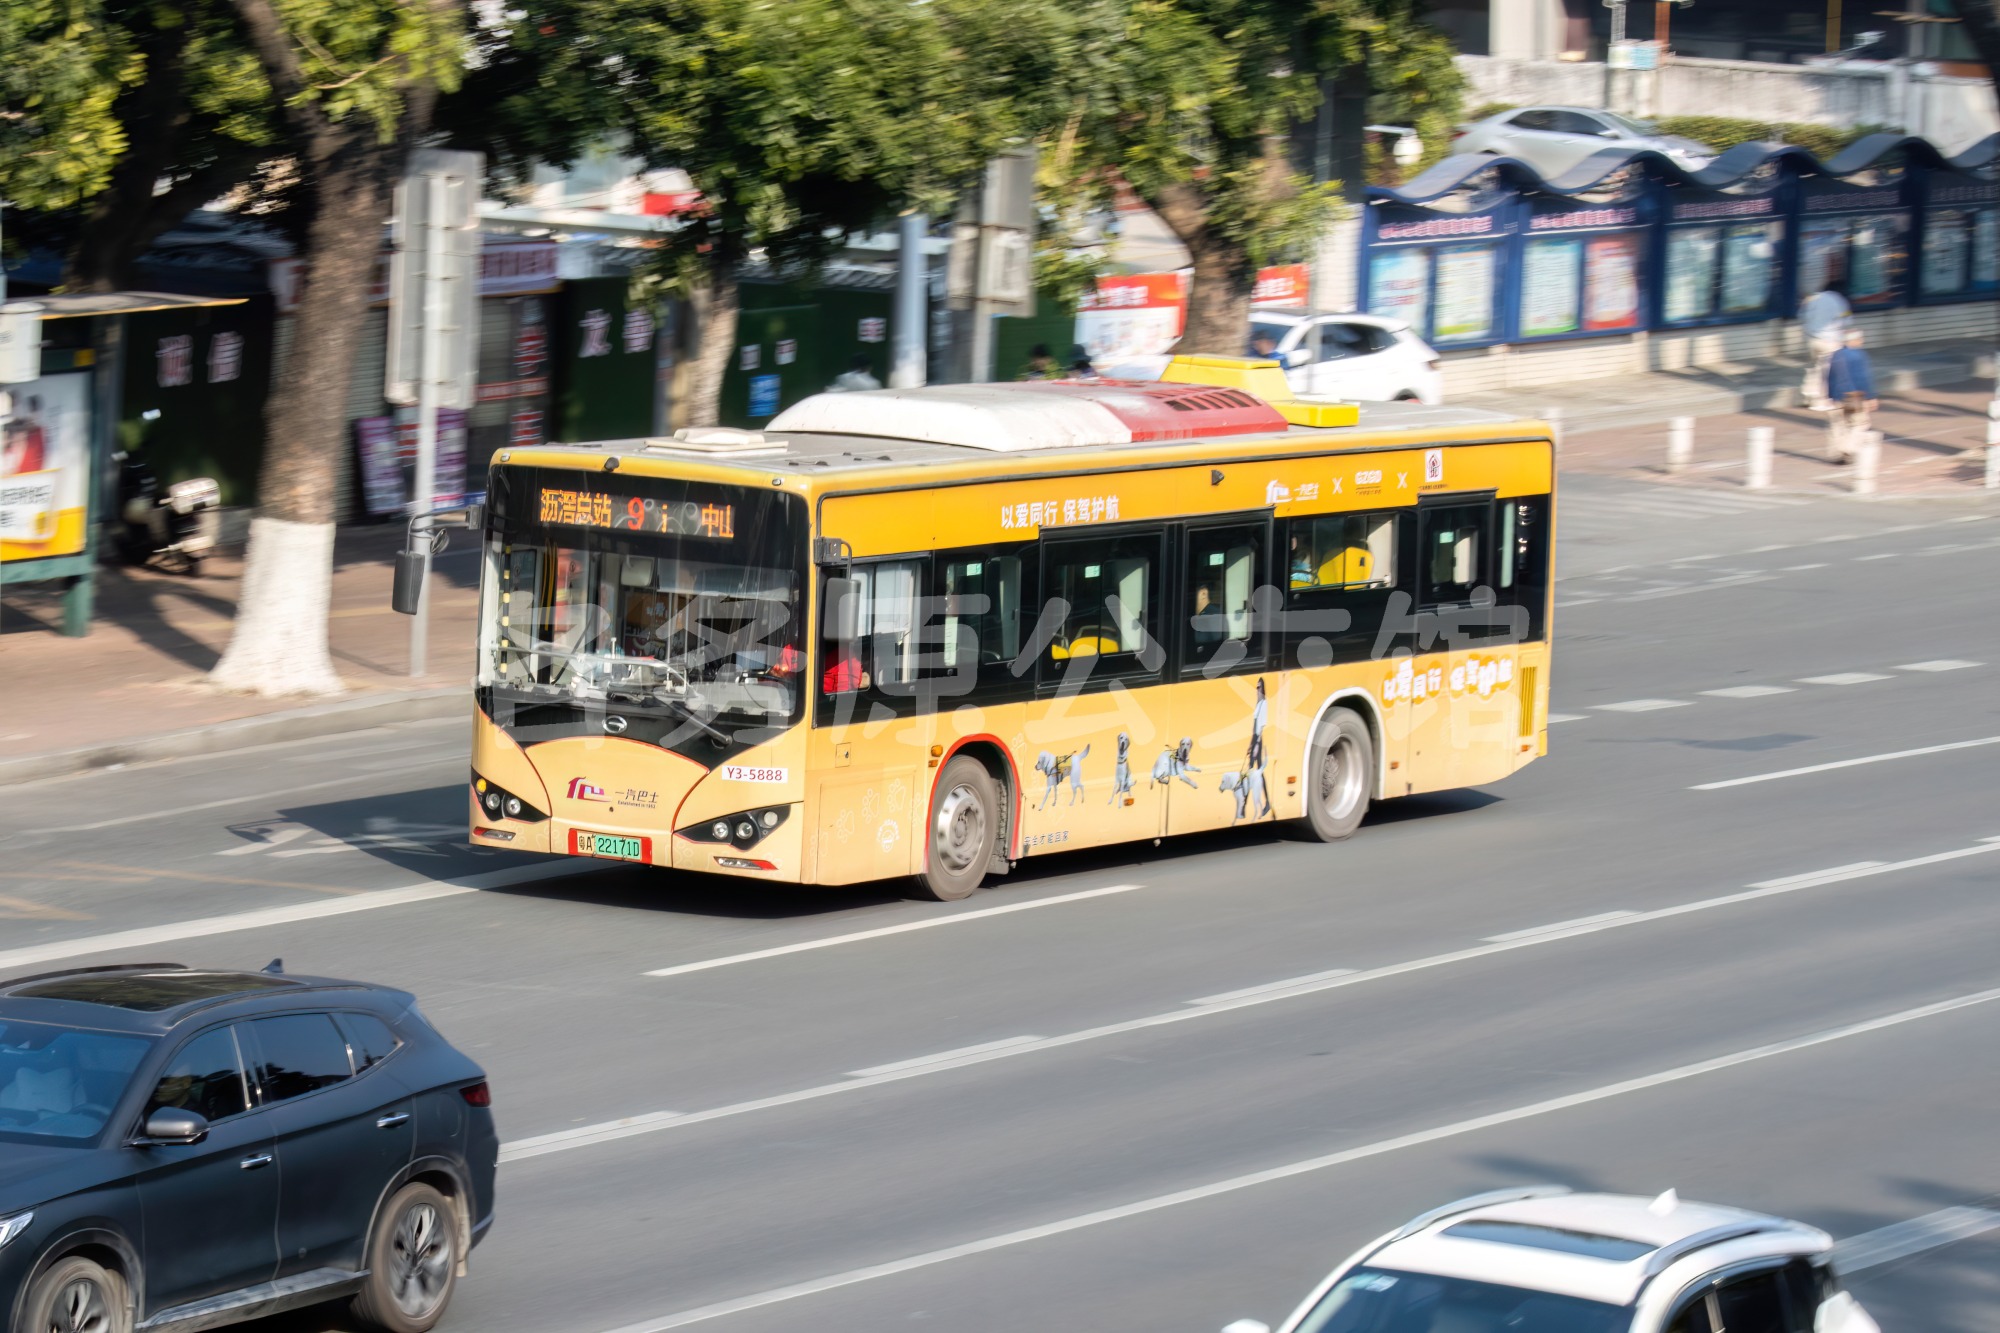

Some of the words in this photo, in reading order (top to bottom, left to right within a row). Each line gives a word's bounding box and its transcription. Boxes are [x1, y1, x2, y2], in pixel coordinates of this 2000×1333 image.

[627, 497, 645, 531] 9
[701, 503, 735, 539] 中山
[1001, 500, 1058, 530] 以爱同行
[1062, 494, 1120, 524] 保驾护航
[726, 767, 783, 782] Y3-5888
